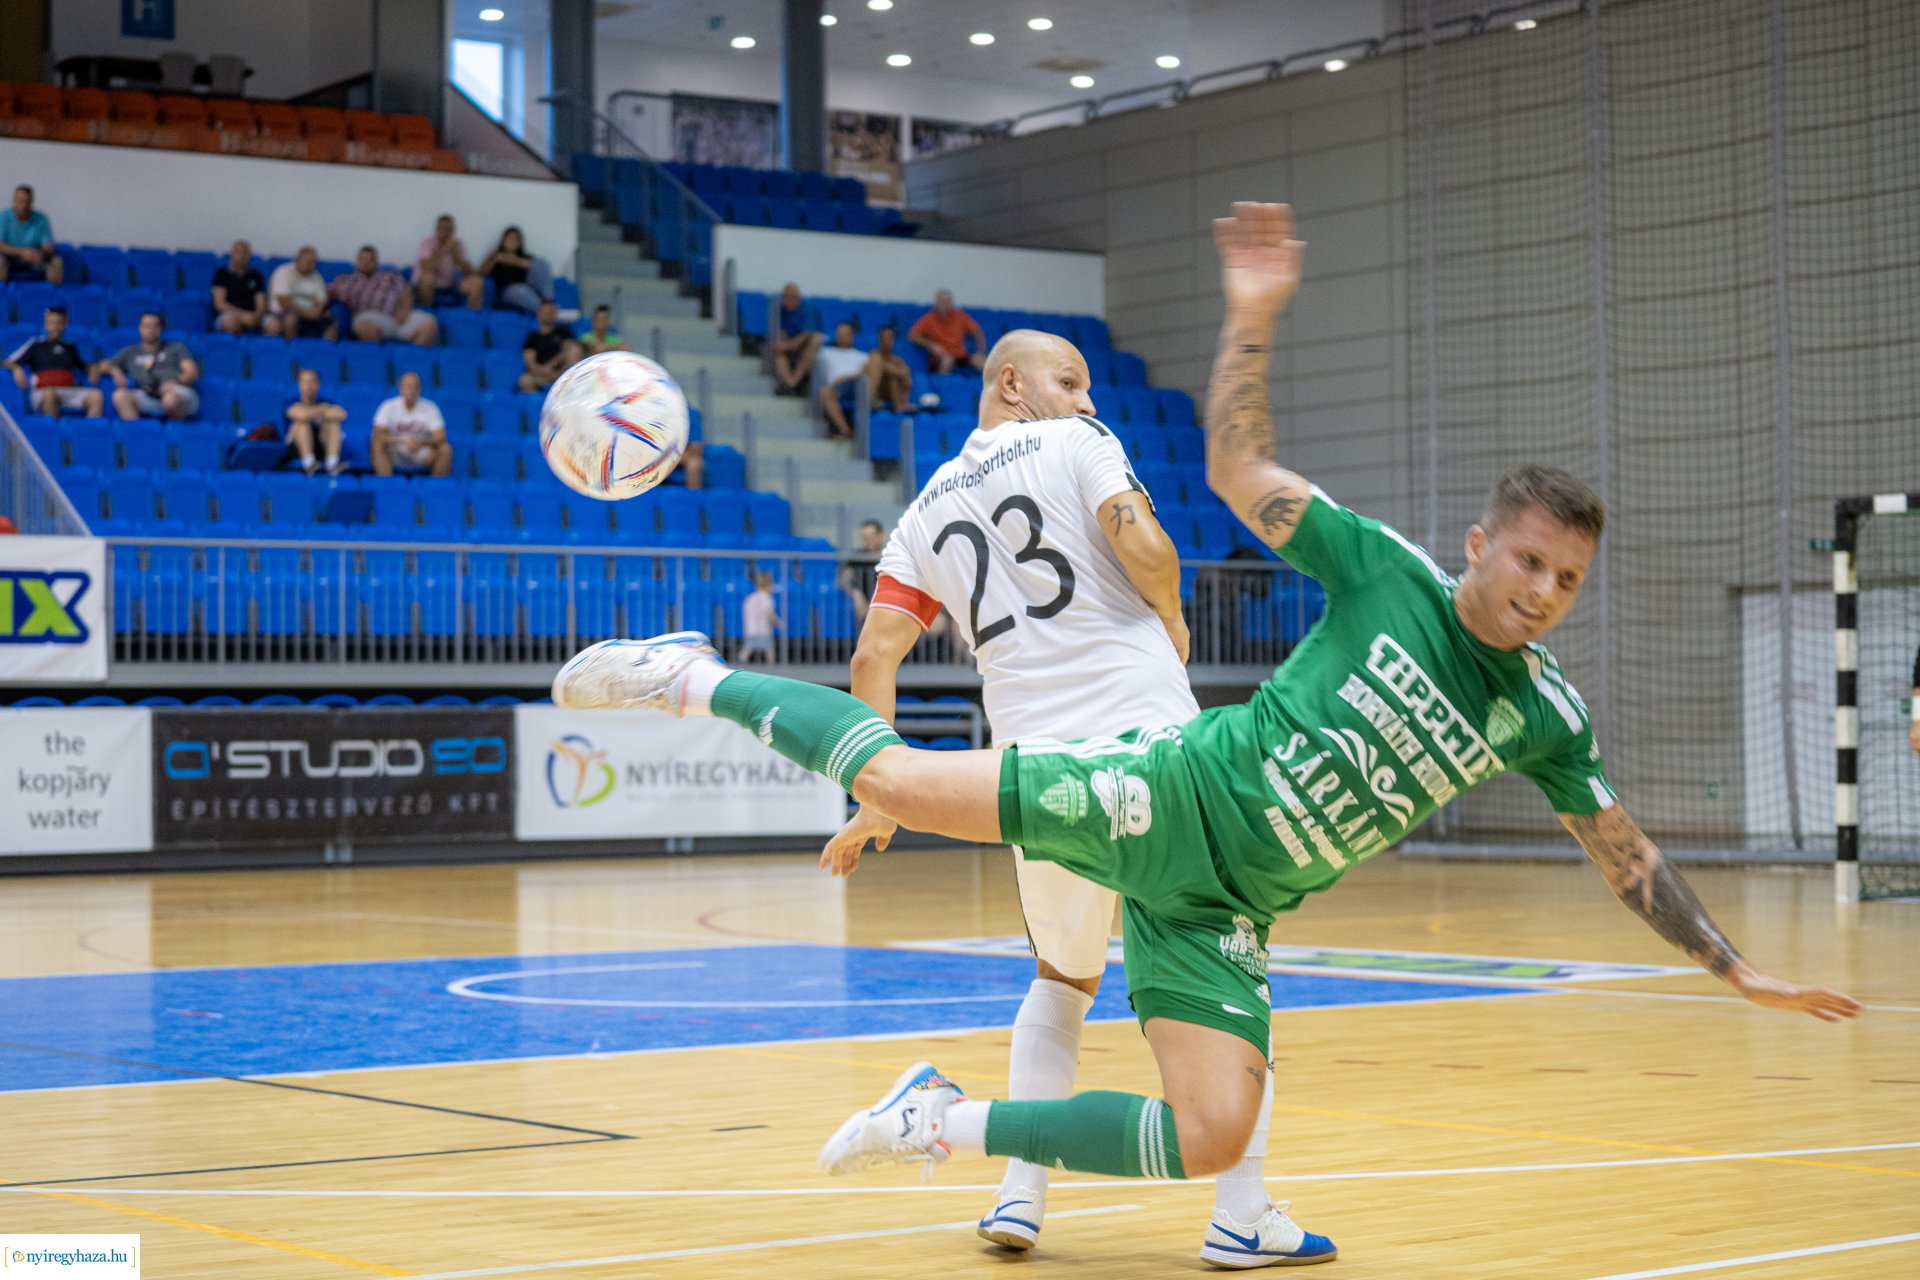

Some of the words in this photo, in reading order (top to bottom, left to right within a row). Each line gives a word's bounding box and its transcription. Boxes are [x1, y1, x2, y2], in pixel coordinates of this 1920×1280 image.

[932, 494, 1076, 650] 23
[44, 729, 86, 756] the
[626, 755, 817, 786] NYÍREGYHÁZA
[448, 791, 499, 814] KFT
[27, 805, 103, 830] water
